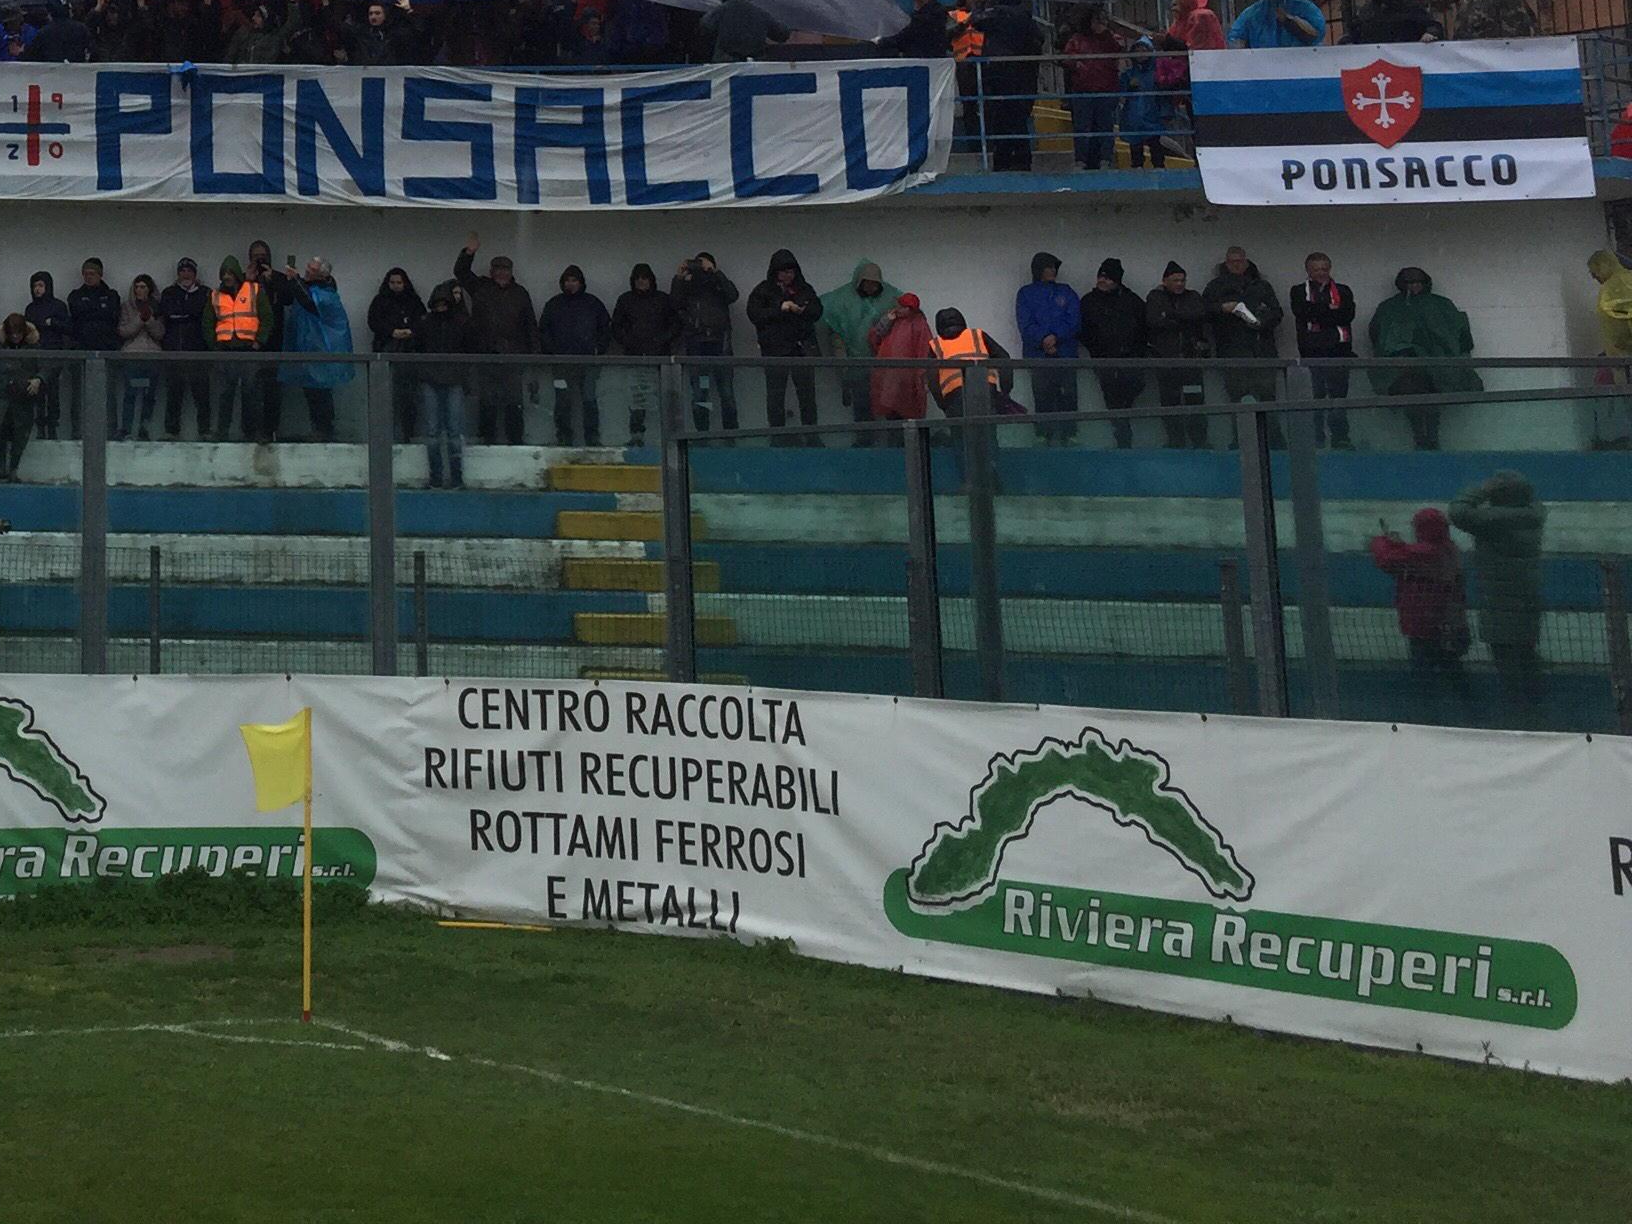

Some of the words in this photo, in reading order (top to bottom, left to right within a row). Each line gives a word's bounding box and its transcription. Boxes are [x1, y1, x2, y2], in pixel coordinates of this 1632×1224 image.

[96, 66, 930, 205] PONSACCO
[1281, 153, 1518, 191] PONSACCO
[458, 687, 610, 733] CENTRO
[626, 693, 807, 746] RACCOLTA
[424, 747, 563, 793] RIFIUTI
[581, 752, 840, 816] RECUPERABILI
[59, 832, 305, 879] Recuperi
[469, 809, 639, 861] ROTTAMI
[656, 819, 806, 879] FERROSI
[547, 876, 567, 919] E
[583, 878, 740, 934] METALLI
[1003, 888, 1193, 960] Riviera
[1211, 910, 1493, 1000] Recuperi
[1496, 986, 1552, 1009] s.r.l.
